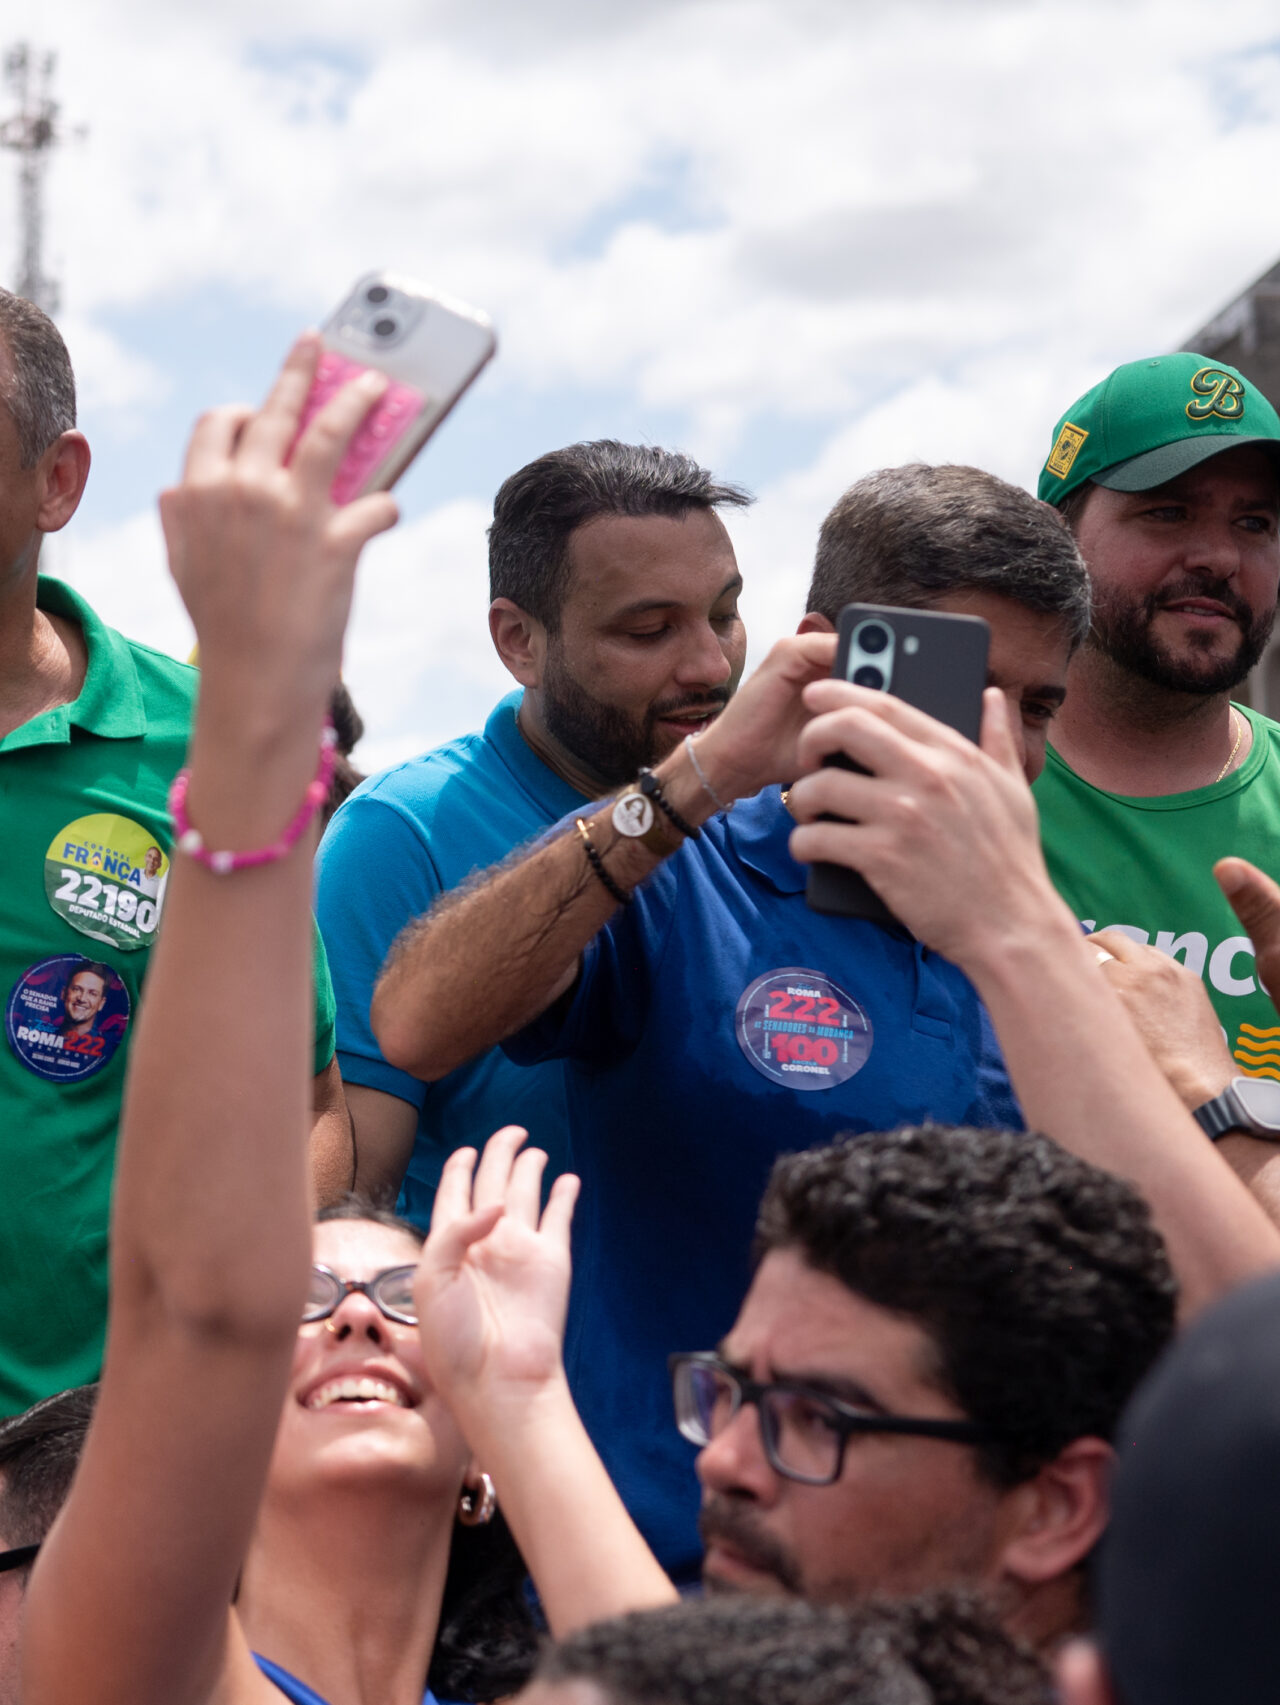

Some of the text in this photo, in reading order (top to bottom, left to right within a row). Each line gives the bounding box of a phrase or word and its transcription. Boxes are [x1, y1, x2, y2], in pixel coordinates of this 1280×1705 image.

[1185, 366, 1246, 421] B
[62, 842, 141, 887] FRANÇA
[84, 841, 130, 862] CORONEL
[54, 868, 158, 934] 22190
[68, 905, 141, 939] DEPUTADO ESTADUAL
[768, 990, 841, 1027] 222
[787, 986, 822, 999] ROMA
[17, 1025, 106, 1057] ROMA 222
[763, 1019, 808, 1035] SENADORES
[771, 1033, 839, 1067] 100
[781, 1063, 831, 1075] CORONEL
